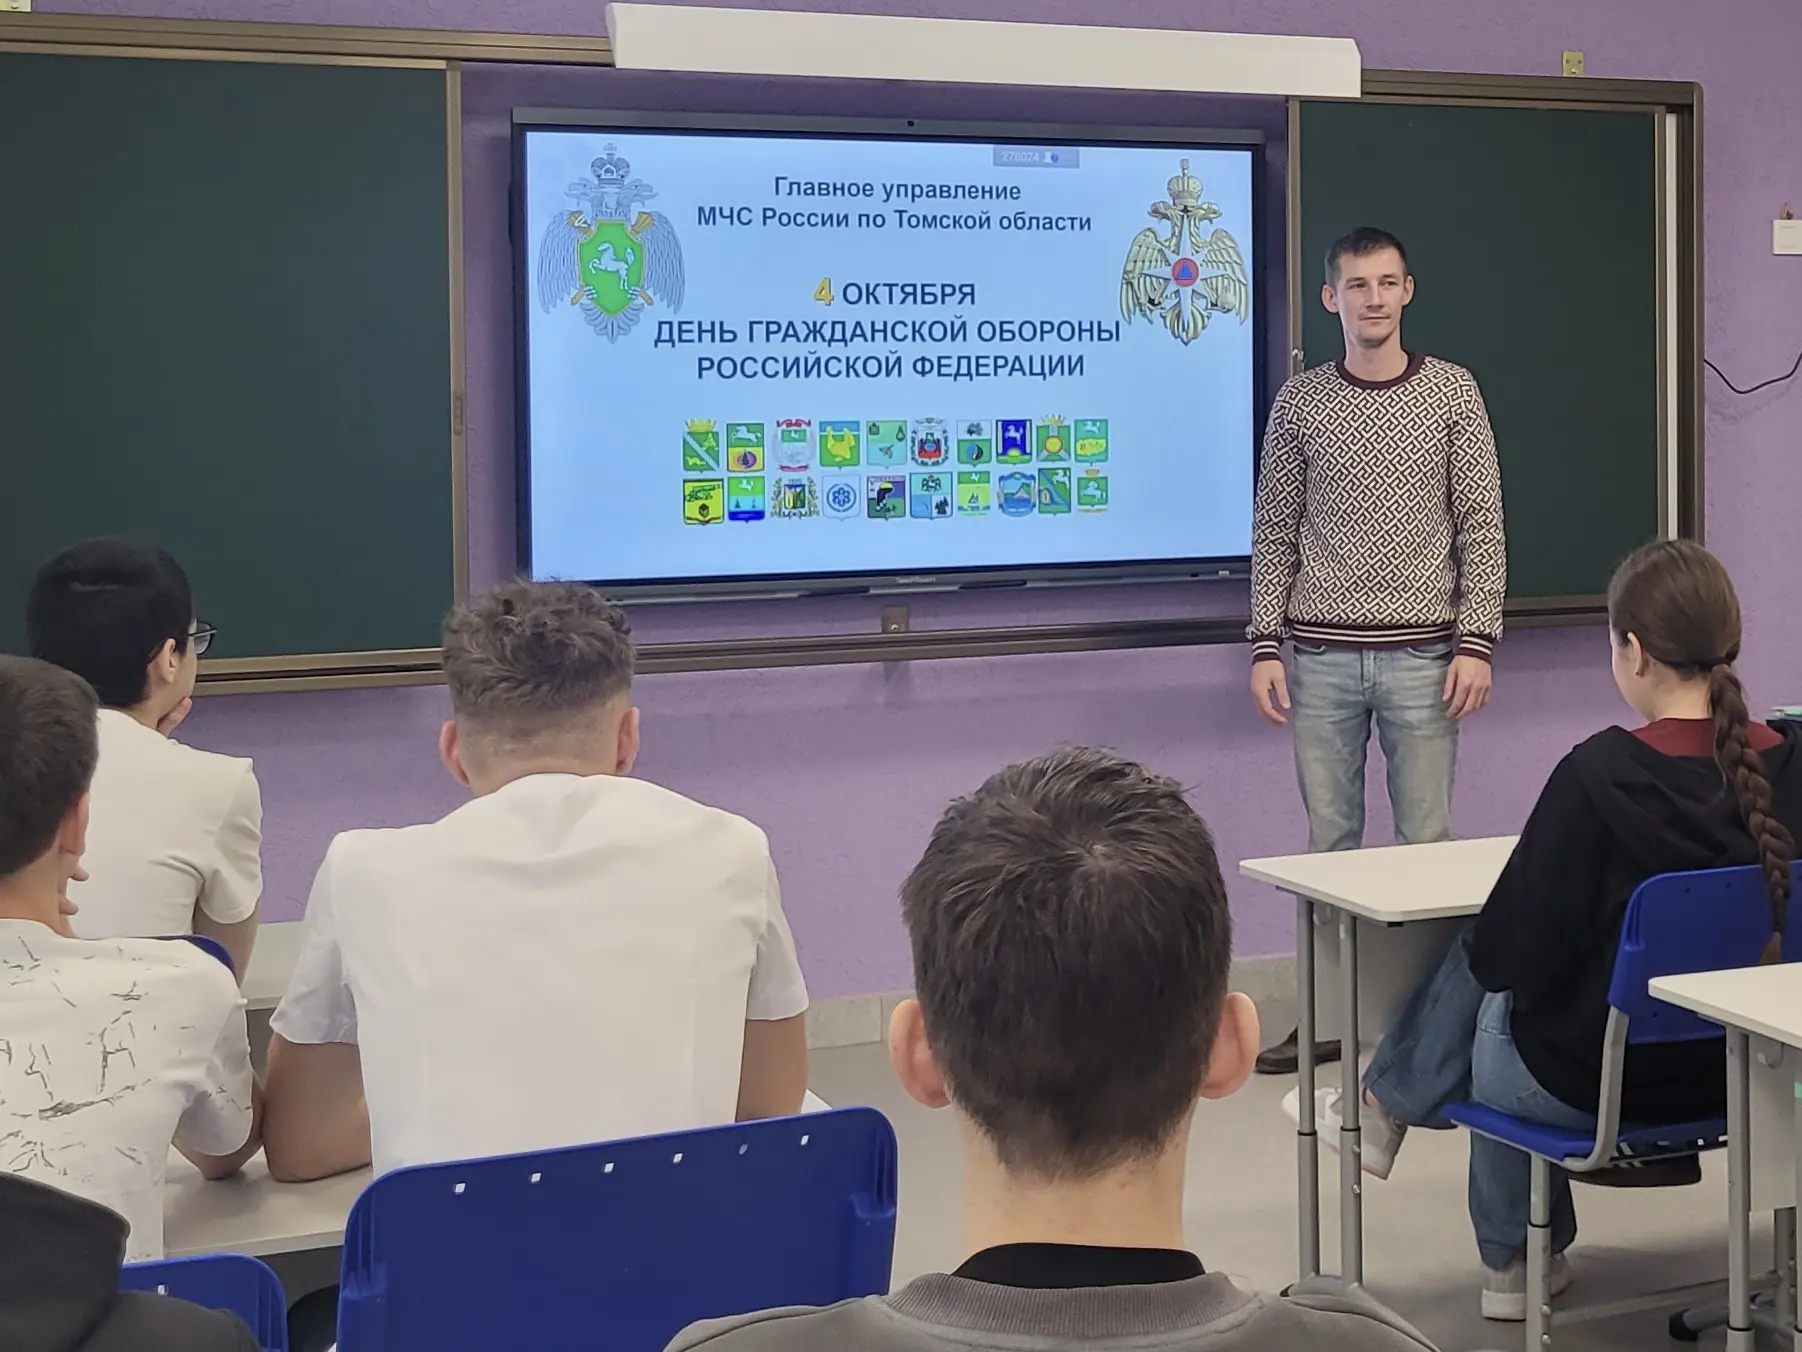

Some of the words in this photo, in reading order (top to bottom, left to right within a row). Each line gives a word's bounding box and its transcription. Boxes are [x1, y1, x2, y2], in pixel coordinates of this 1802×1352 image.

[774, 177, 875, 198] Главное
[881, 183, 1021, 203] управление
[697, 206, 753, 227] МЧС
[762, 207, 850, 228] России
[857, 213, 887, 229] по
[894, 209, 992, 230] Томской
[999, 211, 1091, 232] области
[813, 277, 834, 306] 4
[842, 282, 976, 305] ОКТЯБРЯ
[654, 320, 738, 348] ДЕНЬ
[748, 315, 968, 348] ГРАЖДАНСКОЙ
[976, 320, 1121, 343] ОБОРОНЫ
[697, 350, 903, 380] РОССИЙСКОЙ
[912, 354, 1085, 382] ФЕДЕРАЦИИ
